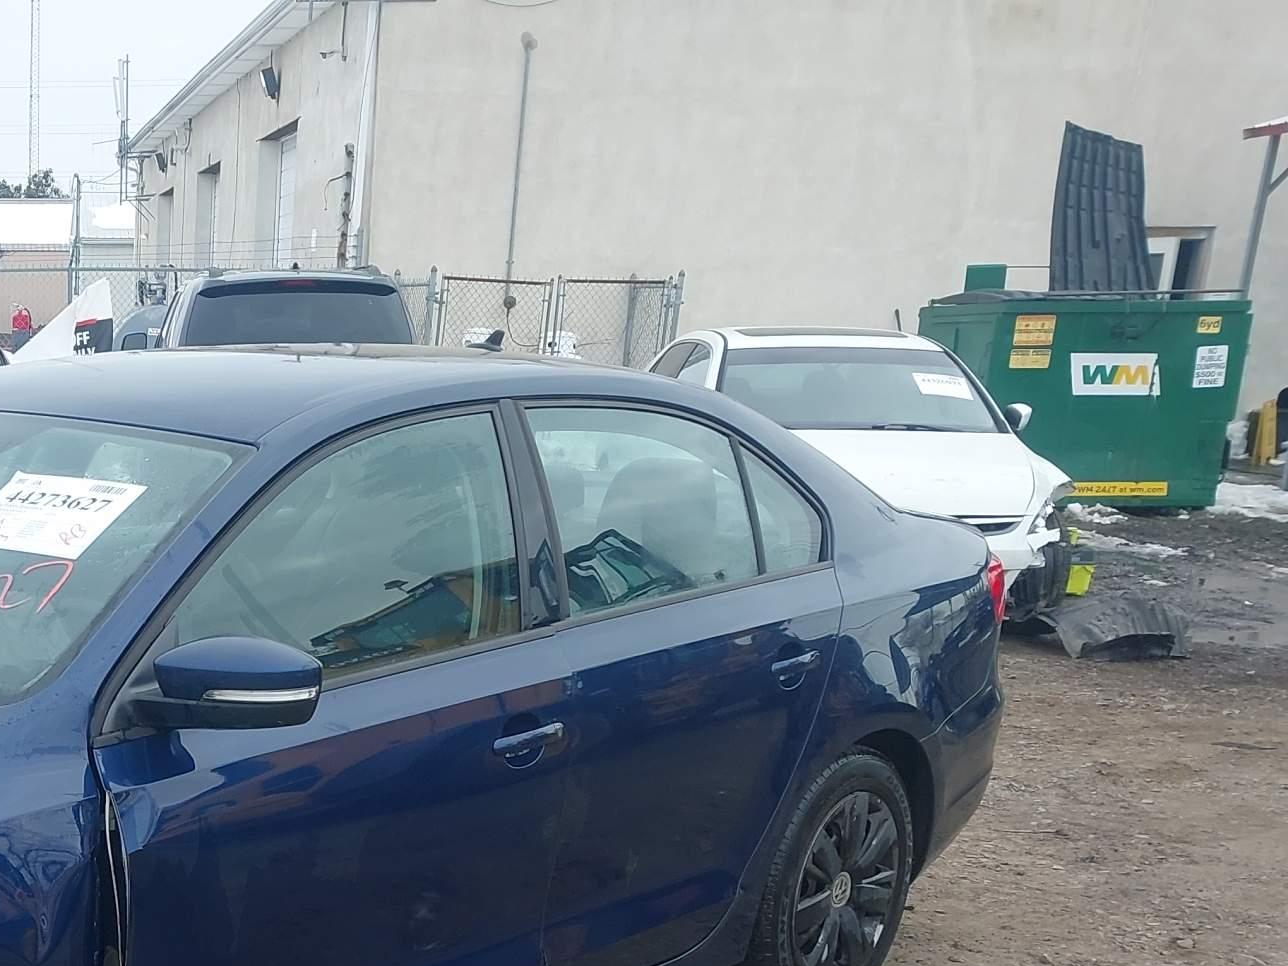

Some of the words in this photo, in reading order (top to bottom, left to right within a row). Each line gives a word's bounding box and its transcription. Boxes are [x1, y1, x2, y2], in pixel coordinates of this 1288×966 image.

[1082, 364, 1150, 385] WM
[1198, 378, 1219, 386] FINE
[6, 490, 113, 513] 44273627
